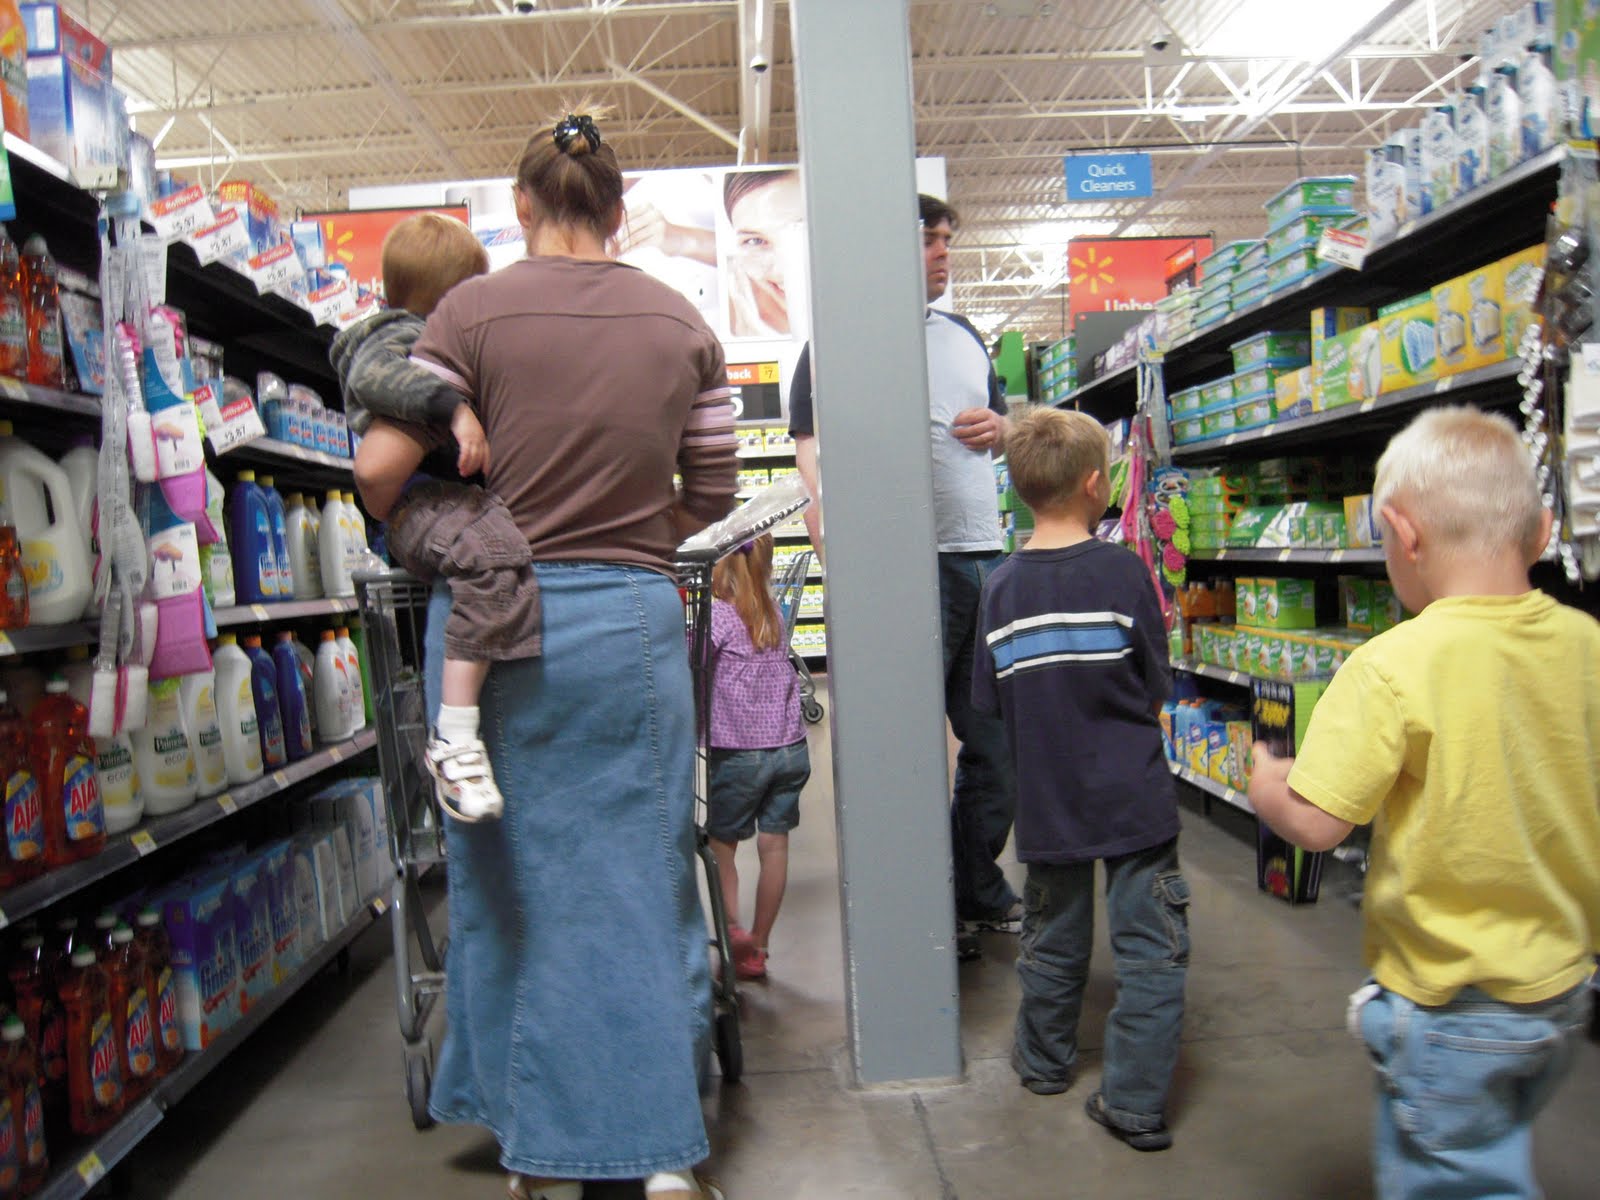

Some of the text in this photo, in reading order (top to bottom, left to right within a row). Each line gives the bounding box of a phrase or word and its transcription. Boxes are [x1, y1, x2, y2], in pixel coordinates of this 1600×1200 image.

[1087, 163, 1127, 178] Quick
[1080, 180, 1137, 193] Cleaners
[727, 368, 752, 380] back
[223, 400, 250, 419] ollback
[70, 774, 98, 817] AJA
[13, 790, 41, 835] AJA
[128, 1012, 151, 1051] AJA
[93, 1038, 118, 1080] AJA
